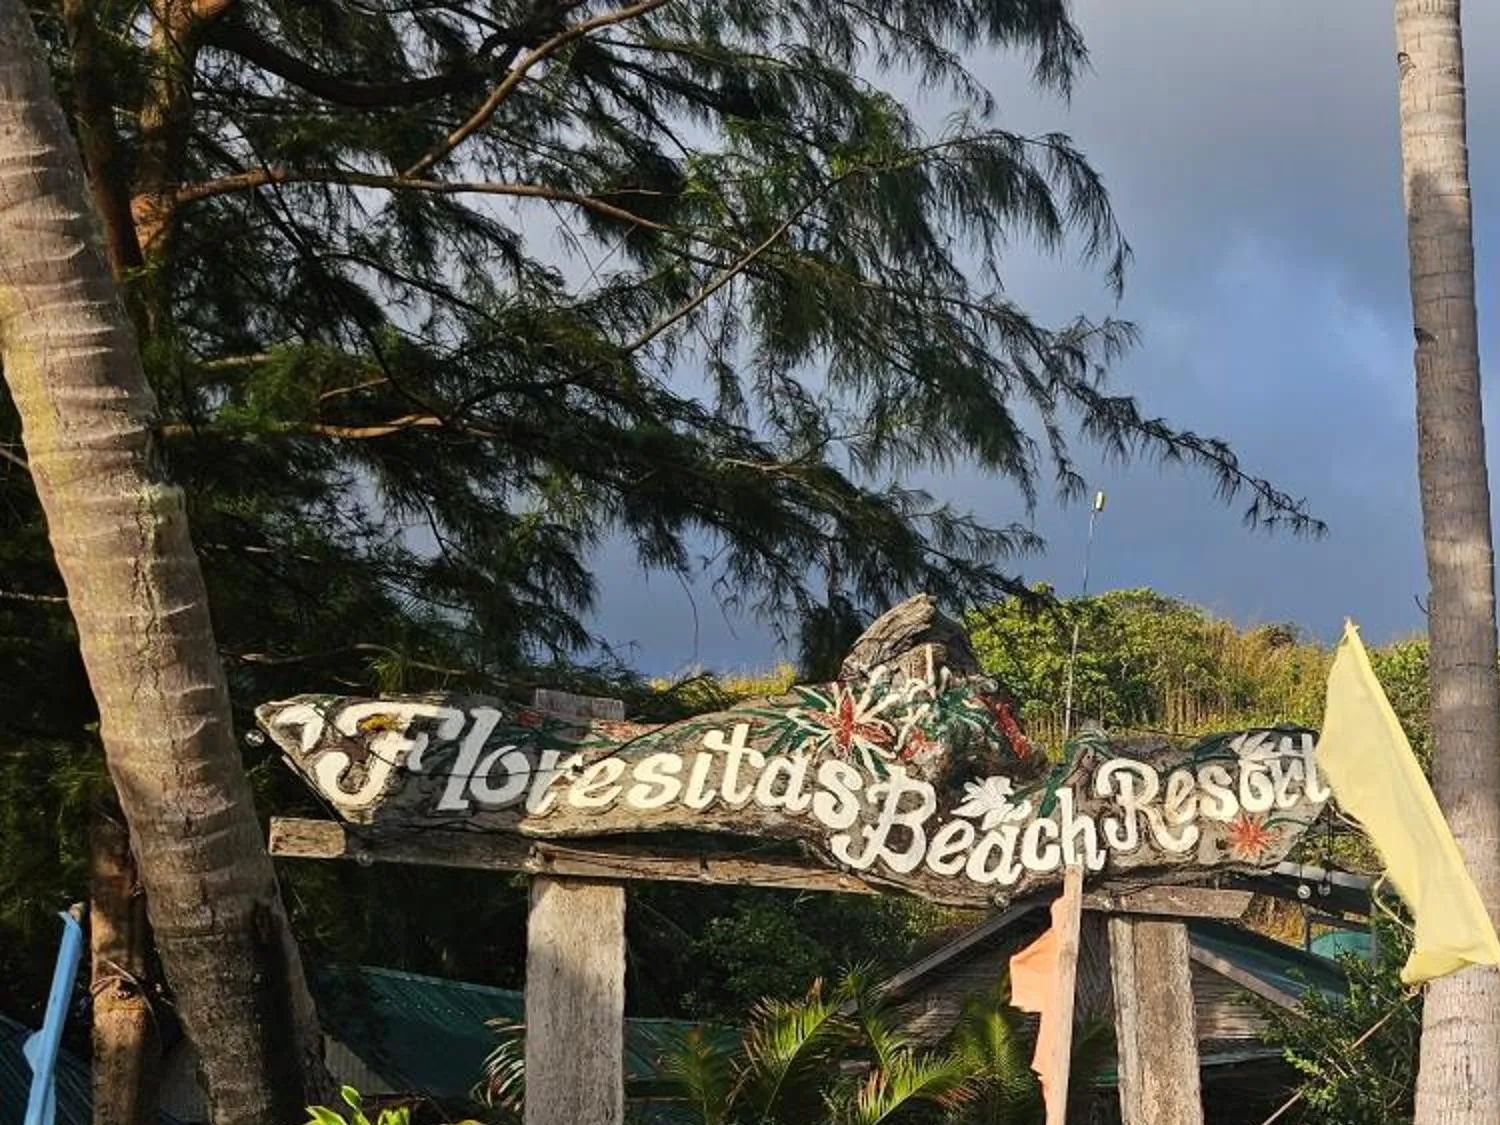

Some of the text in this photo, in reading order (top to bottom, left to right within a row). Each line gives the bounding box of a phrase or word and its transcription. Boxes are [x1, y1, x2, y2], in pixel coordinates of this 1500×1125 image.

[274, 702, 1331, 885] Floresitas Beach Resort
